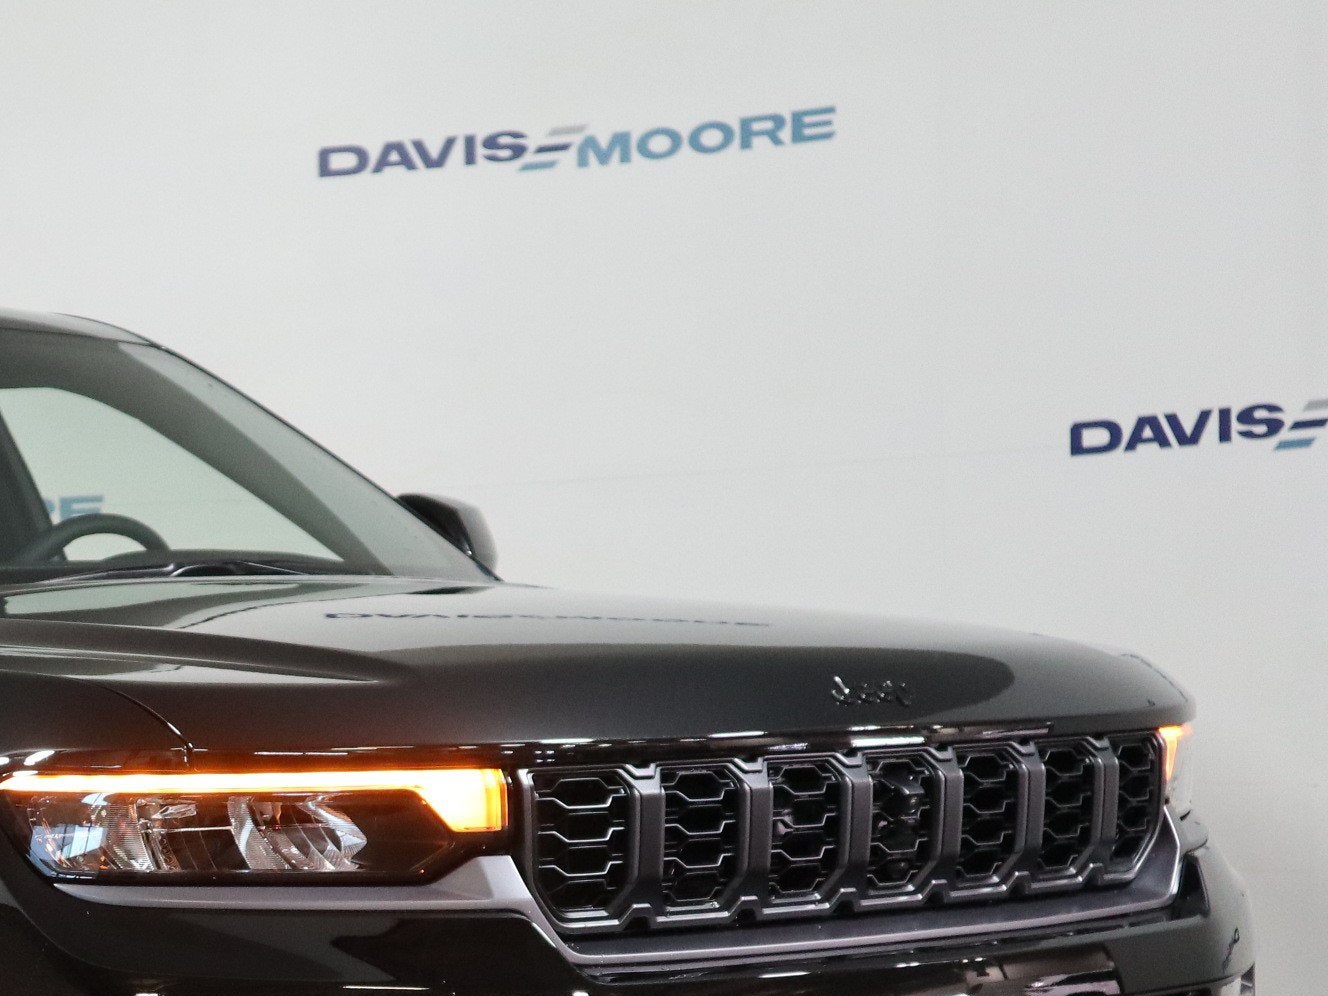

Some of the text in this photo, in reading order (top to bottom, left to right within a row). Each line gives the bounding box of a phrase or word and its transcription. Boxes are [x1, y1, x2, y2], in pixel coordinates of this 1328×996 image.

[317, 105, 837, 179] DAVIS MOORE
[1068, 401, 1286, 458] DAVIS
